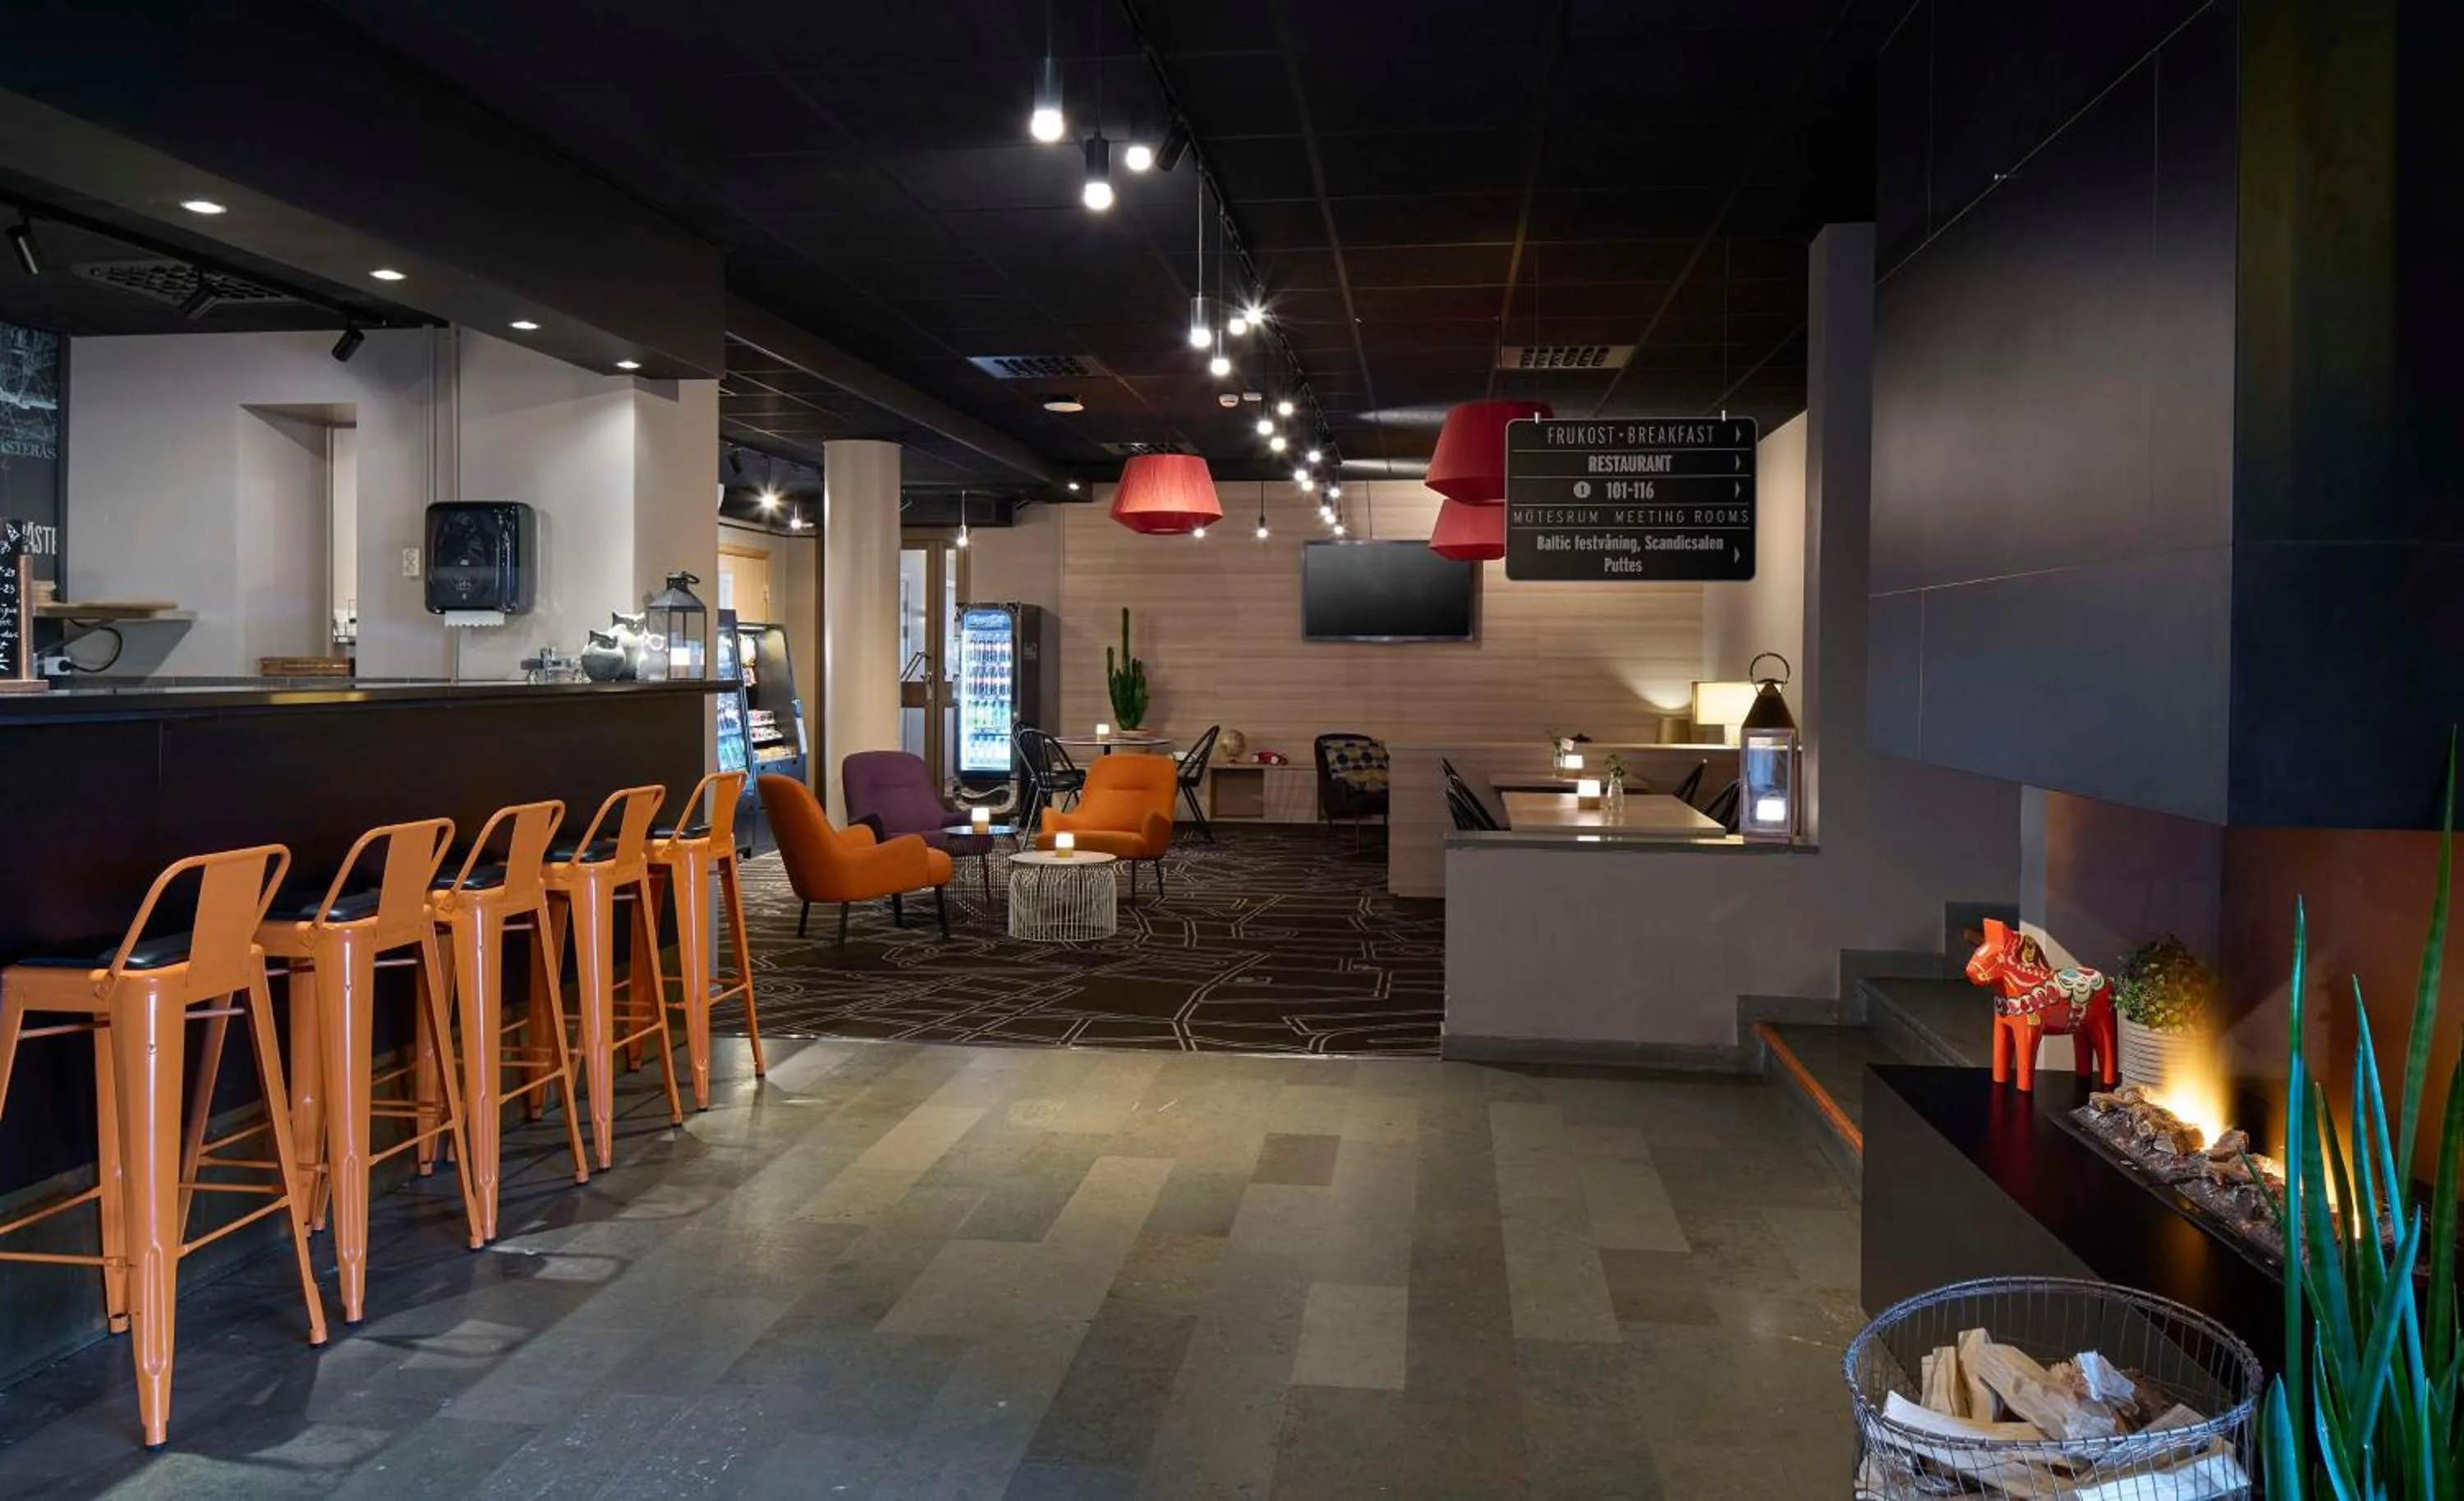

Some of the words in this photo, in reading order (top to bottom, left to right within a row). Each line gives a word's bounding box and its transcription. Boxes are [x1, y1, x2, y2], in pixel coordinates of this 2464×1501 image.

[1547, 426, 1615, 445] FRUKOST
[1627, 425, 1714, 444] BREAKFAST
[1588, 454, 1673, 473] RESTAURANT
[1606, 481, 1655, 499] 101-116
[1615, 510, 1685, 524] MEETING
[1694, 509, 1749, 523] ROOMS
[1537, 535, 1572, 551] Baltic
[1574, 534, 1642, 554] festvåning,
[1644, 535, 1724, 551] Scandicsalen
[1604, 558, 1643, 573] Puttes
